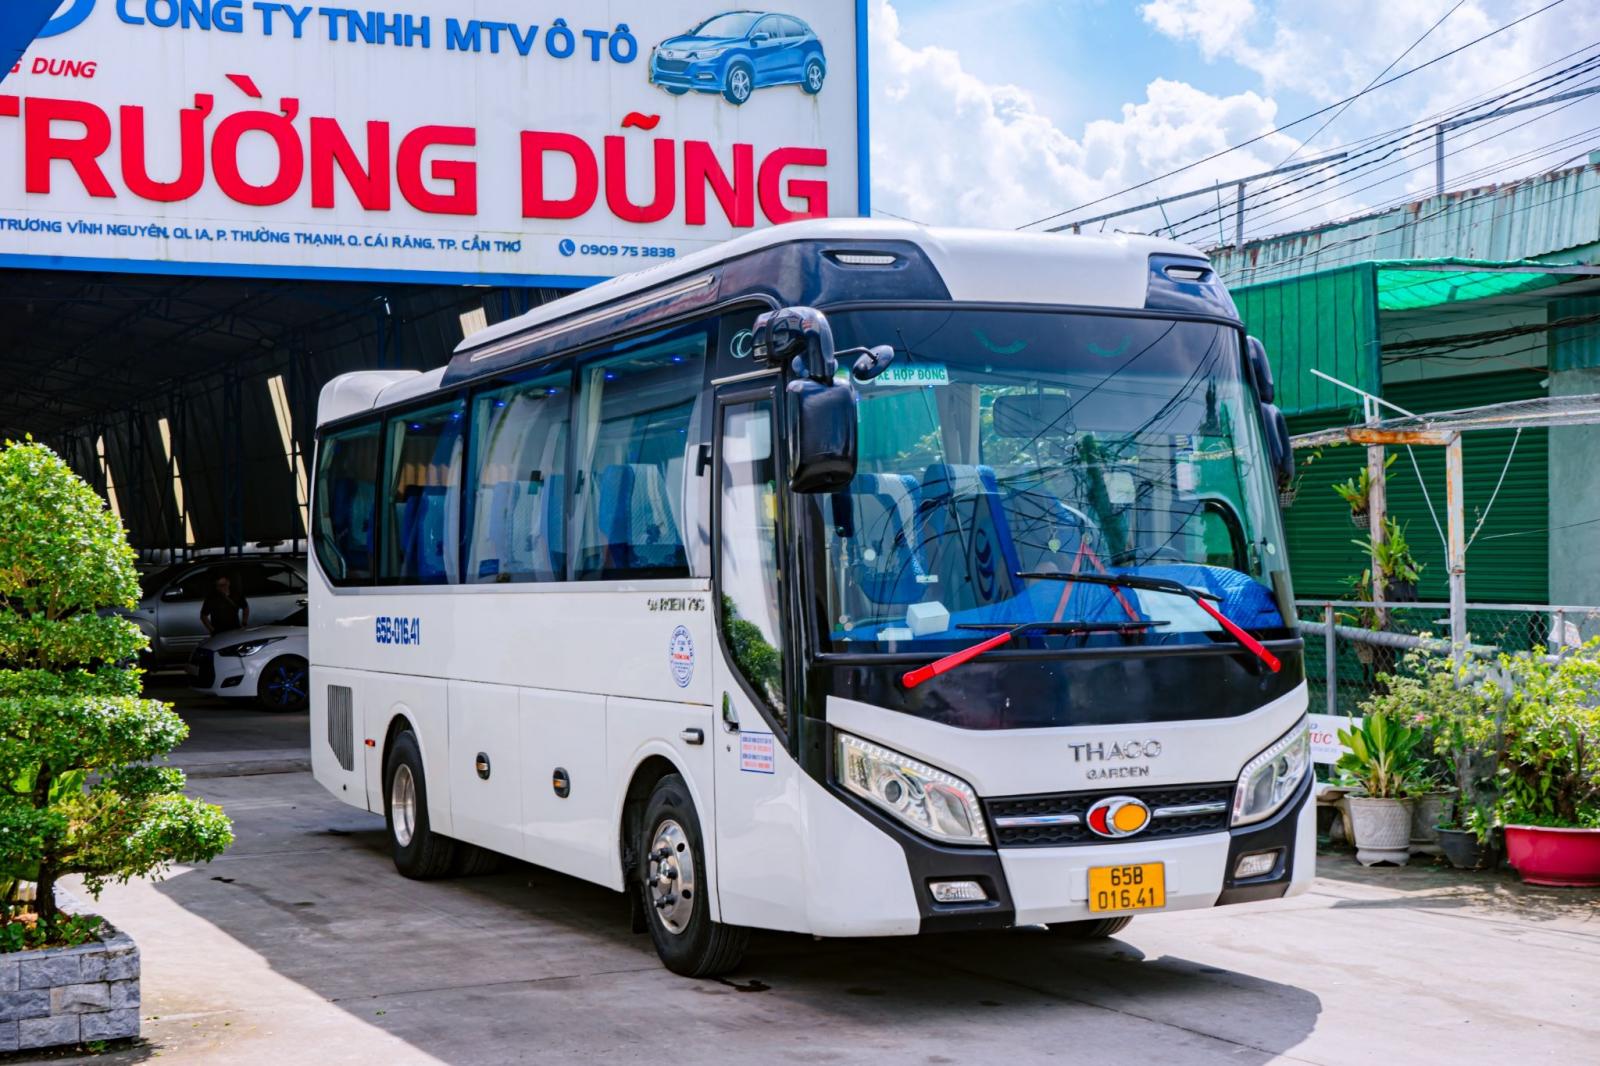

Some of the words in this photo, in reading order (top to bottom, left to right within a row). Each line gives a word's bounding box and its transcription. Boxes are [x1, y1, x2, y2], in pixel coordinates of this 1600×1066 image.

[253, 2, 313, 38] TY
[319, 7, 430, 49] TNHH
[446, 18, 539, 56] MTV
[545, 18, 576, 59] Ô
[583, 23, 639, 64] TÔ
[31, 57, 97, 78] DUNG
[0, 74, 477, 215] RƯỜNG
[520, 112, 829, 228] DŨNG
[67, 220, 103, 236] VĨNH
[173, 227, 192, 239] QL
[216, 229, 228, 241] P.
[230, 226, 290, 244] THƯỜNG
[364, 232, 388, 248] CÁI
[437, 238, 458, 250] TP.
[493, 239, 521, 253] THƠ
[580, 244, 618, 256] 0909
[621, 246, 638, 257] 75
[641, 246, 676, 258] 3838
[1068, 740, 1162, 762] THACO
[1086, 766, 1150, 780] GARDEN
[1111, 866, 1144, 887] 65B
[1098, 887, 1155, 910] 016.41
